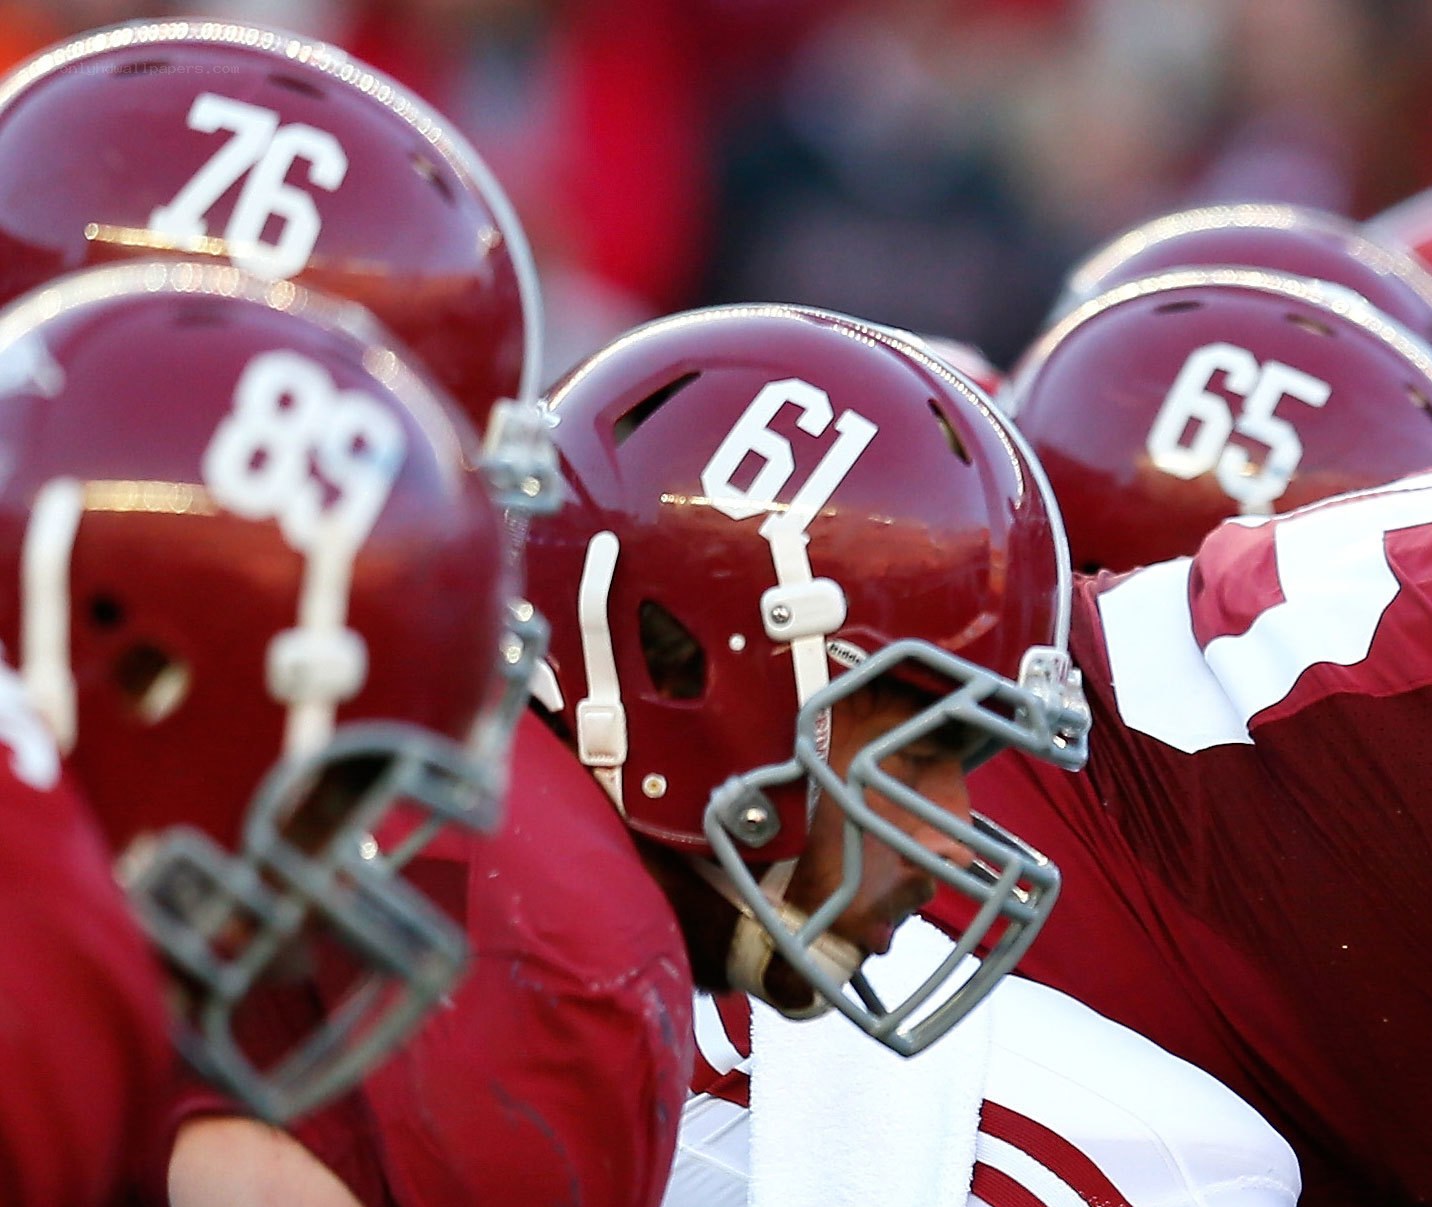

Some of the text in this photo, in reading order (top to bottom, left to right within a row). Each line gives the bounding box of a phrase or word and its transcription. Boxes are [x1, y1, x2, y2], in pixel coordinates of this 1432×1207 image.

[149, 91, 348, 284] 76
[203, 348, 408, 554] 89
[701, 377, 878, 546] 61
[1147, 342, 1333, 507] 65
